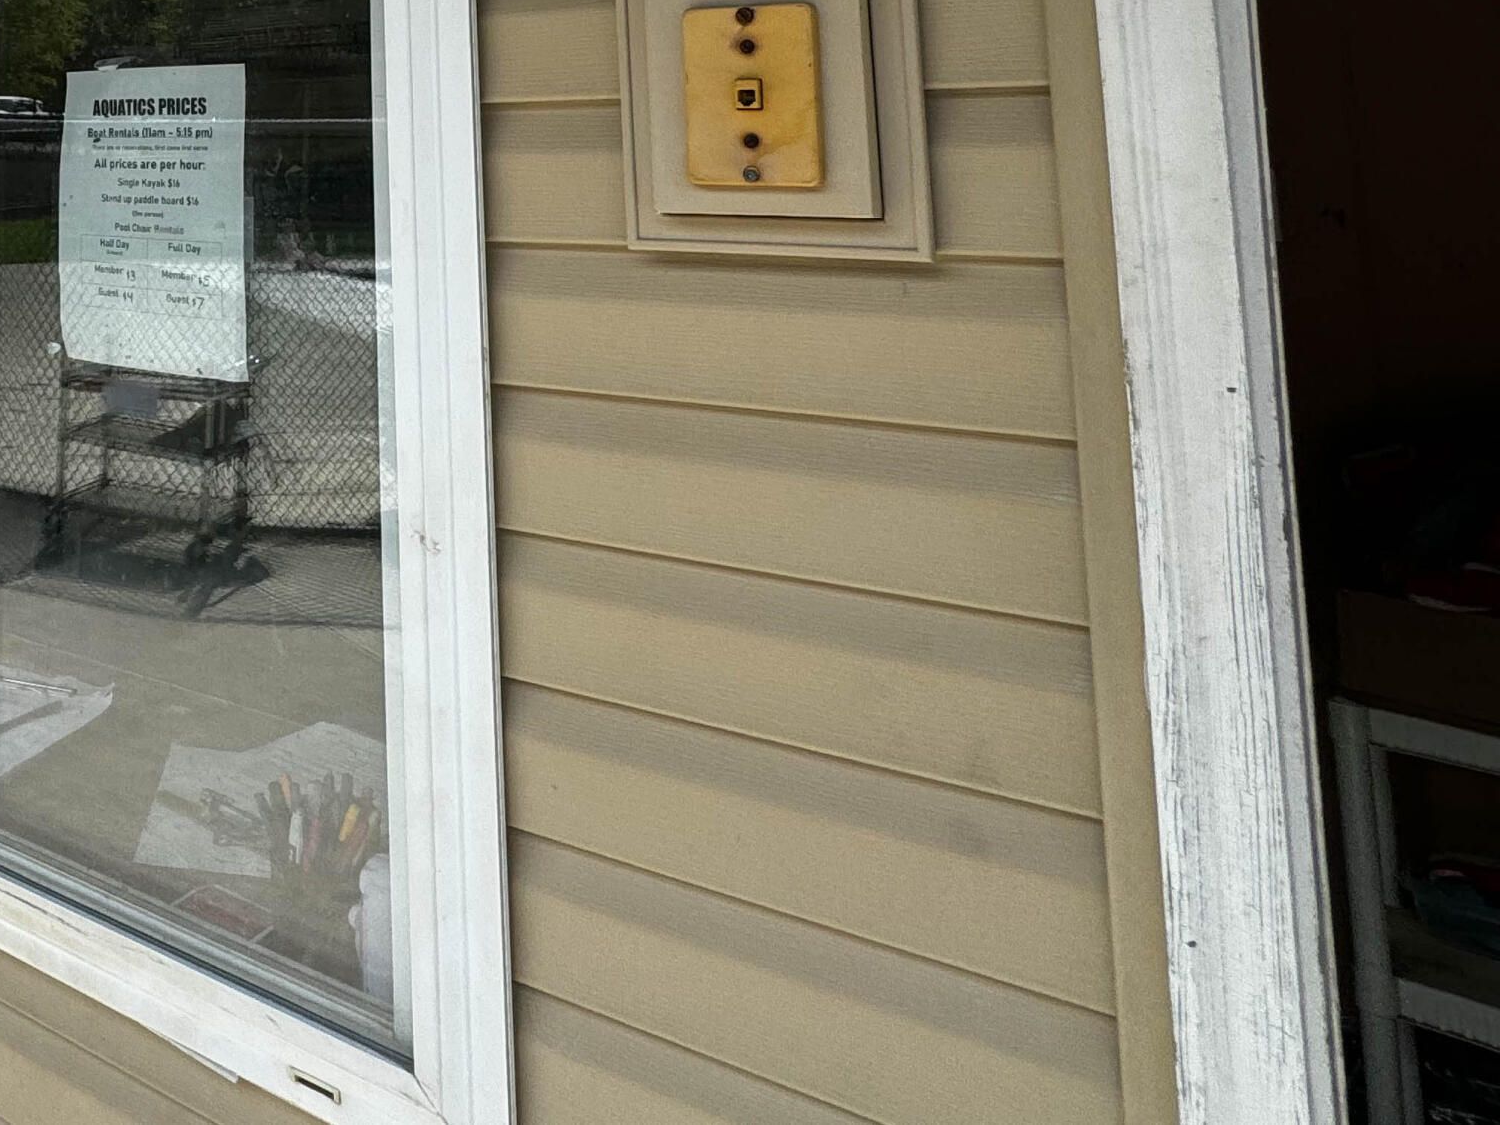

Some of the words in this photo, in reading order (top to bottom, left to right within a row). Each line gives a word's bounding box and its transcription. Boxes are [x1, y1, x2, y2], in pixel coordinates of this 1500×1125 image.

[92, 98, 155, 118] AQUATICS
[158, 97, 207, 116] PRICES
[87, 127, 106, 138] Boat
[108, 127, 140, 138] Rentals
[195, 126, 213, 139] pm)
[94, 159, 107, 169] All
[109, 158, 137, 172] prices
[140, 161, 157, 170] are
[159, 161, 177, 172] per
[179, 159, 206, 171] hour:
[117, 179, 140, 189] Single
[141, 179, 165, 189] Kayak
[101, 194, 121, 204] Stand
[123, 196, 132, 204] up
[134, 196, 159, 206] paddle
[161, 196, 184, 206] board
[100, 238, 114, 247] Half
[115, 239, 130, 251] Day
[168, 242, 183, 252] Full
[185, 243, 201, 255] Day
